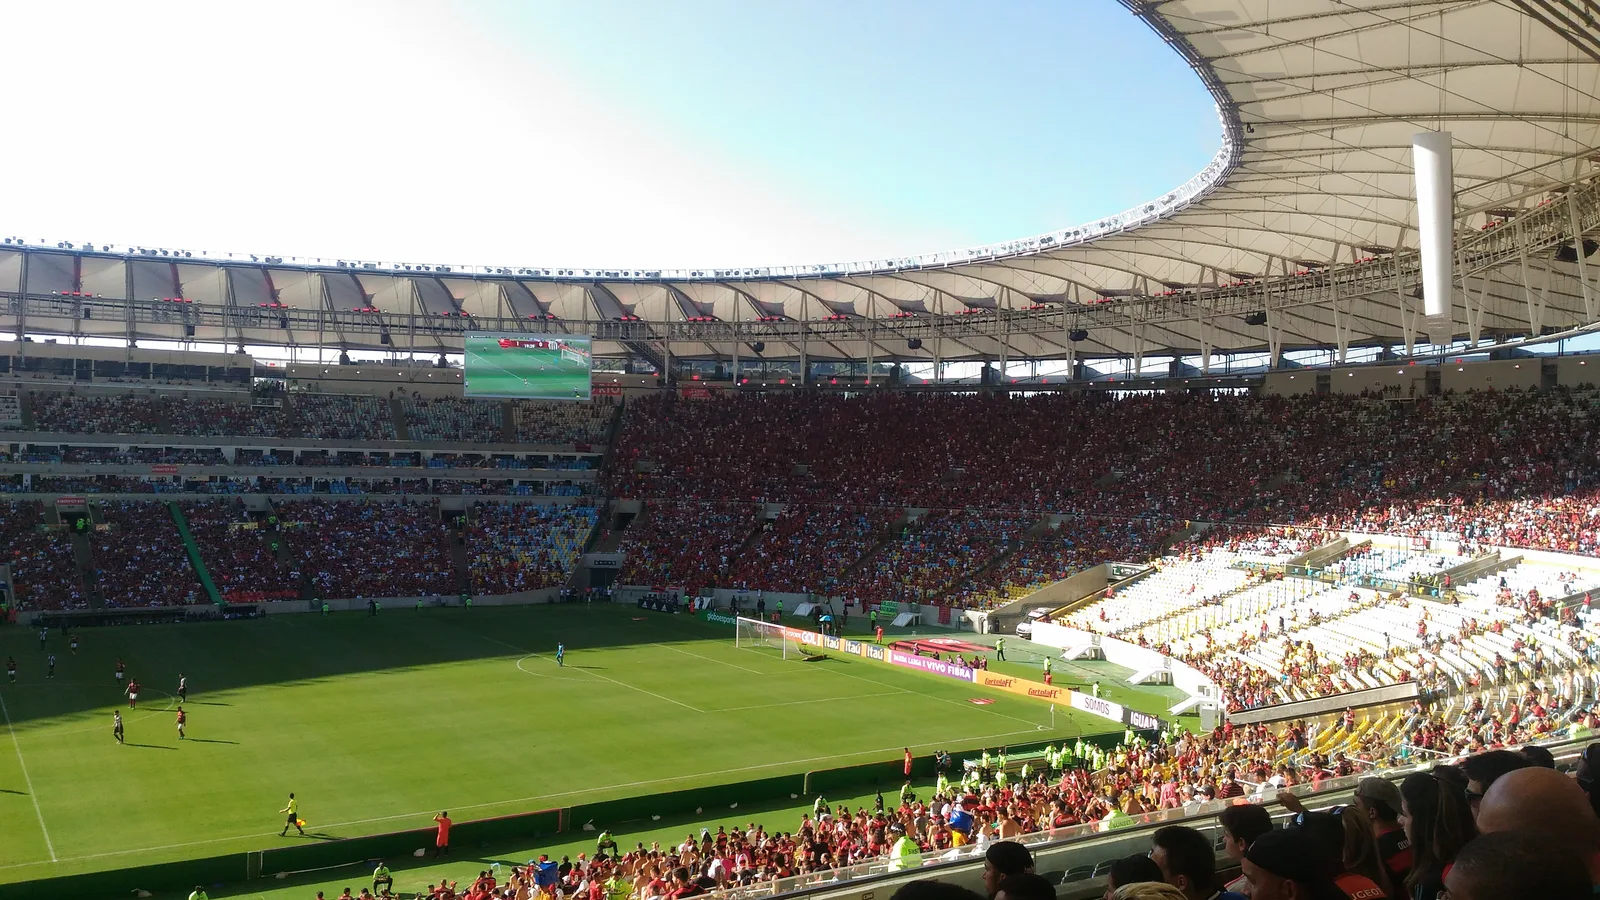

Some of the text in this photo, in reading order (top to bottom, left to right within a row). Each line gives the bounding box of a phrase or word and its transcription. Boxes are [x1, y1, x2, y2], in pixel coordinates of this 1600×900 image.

[802, 631, 816, 645] GOL
[824, 635, 839, 649] Itaú
[845, 640, 861, 655] Itaú
[867, 645, 883, 660] Itaú
[927, 660, 946, 672] VIVO
[948, 666, 971, 679] FIBRA
[1085, 697, 1110, 715] SOMOS
